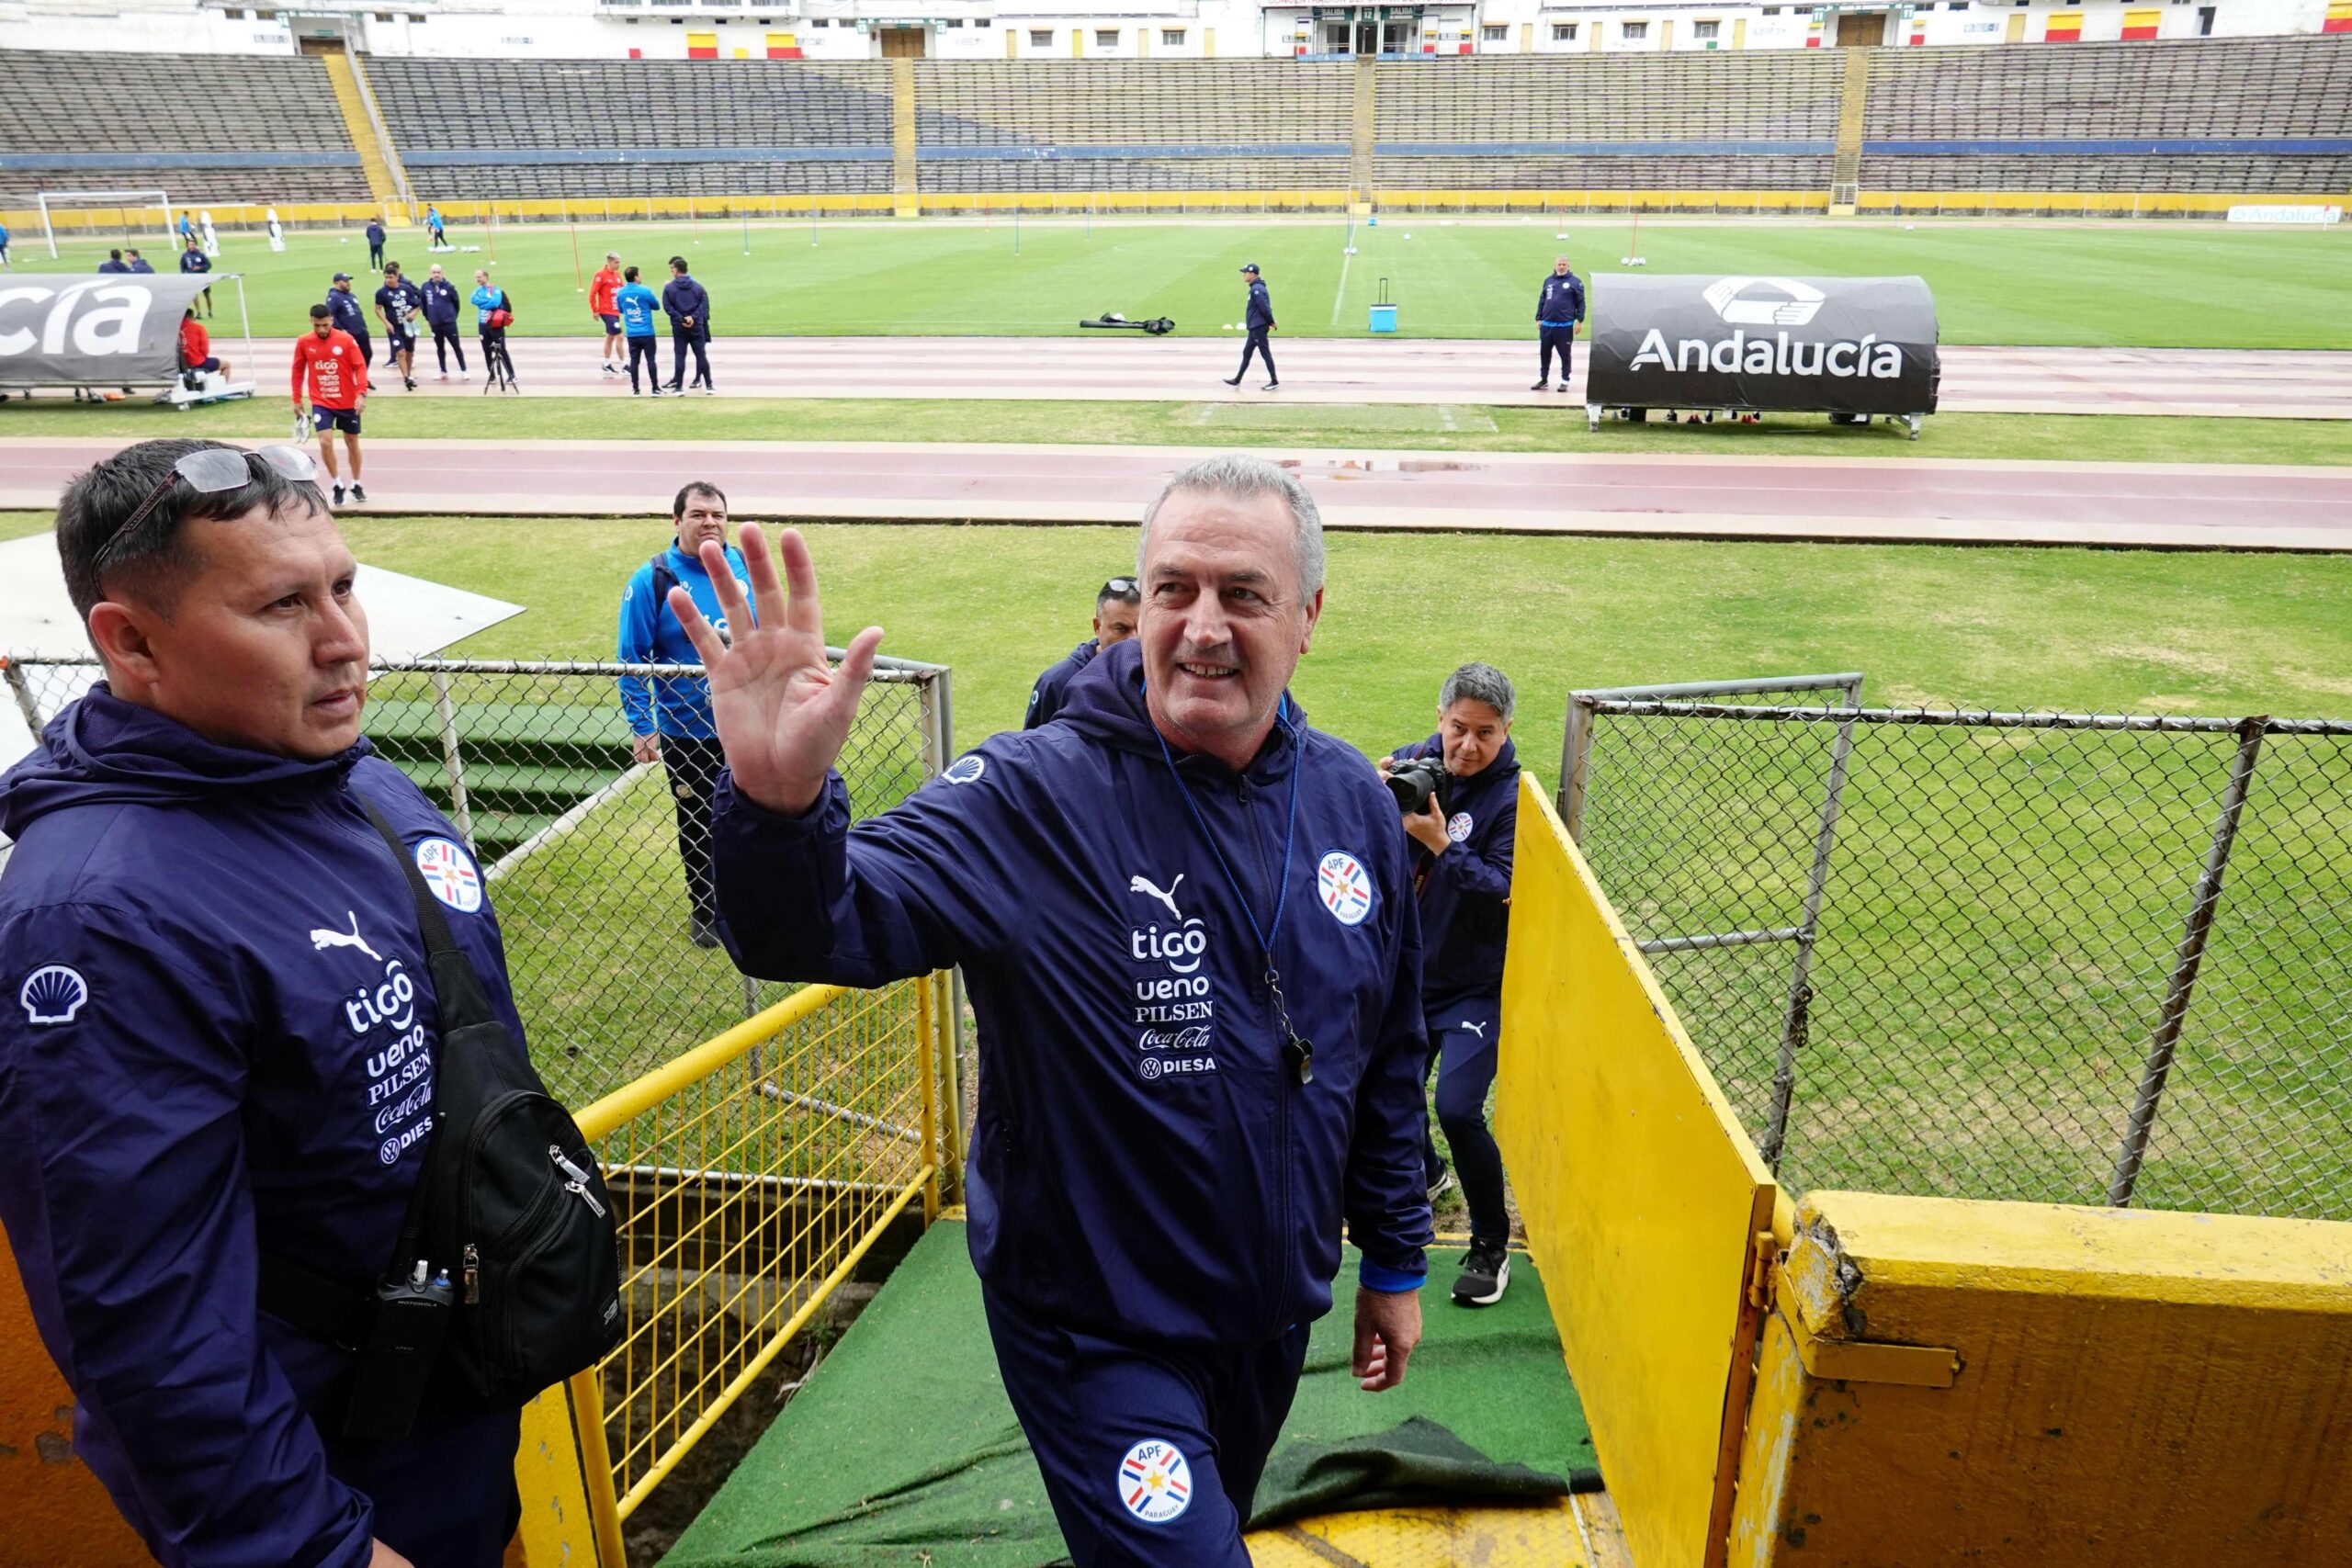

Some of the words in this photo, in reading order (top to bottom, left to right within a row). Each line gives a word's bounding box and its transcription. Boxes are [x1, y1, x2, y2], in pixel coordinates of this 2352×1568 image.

[1363, 11, 1373, 19] 12
[1630, 329, 1902, 378] Andalucía
[422, 844, 439, 863] APF
[1328, 858, 1344, 870] APF
[1131, 918, 1207, 973] tigo
[345, 959, 413, 1033] tigo
[1136, 976, 1209, 1000] ueno
[1135, 1000, 1213, 1024] PILSEN
[1139, 1025, 1212, 1050] Coca-Cola
[367, 1024, 424, 1077] ueno
[368, 1048, 431, 1106] PILSEN
[1163, 1058, 1216, 1074] DIESA
[401, 1115, 434, 1149] DIES
[1138, 1445, 1161, 1461] APF
[1145, 1506, 1179, 1518] PARAGUAY
